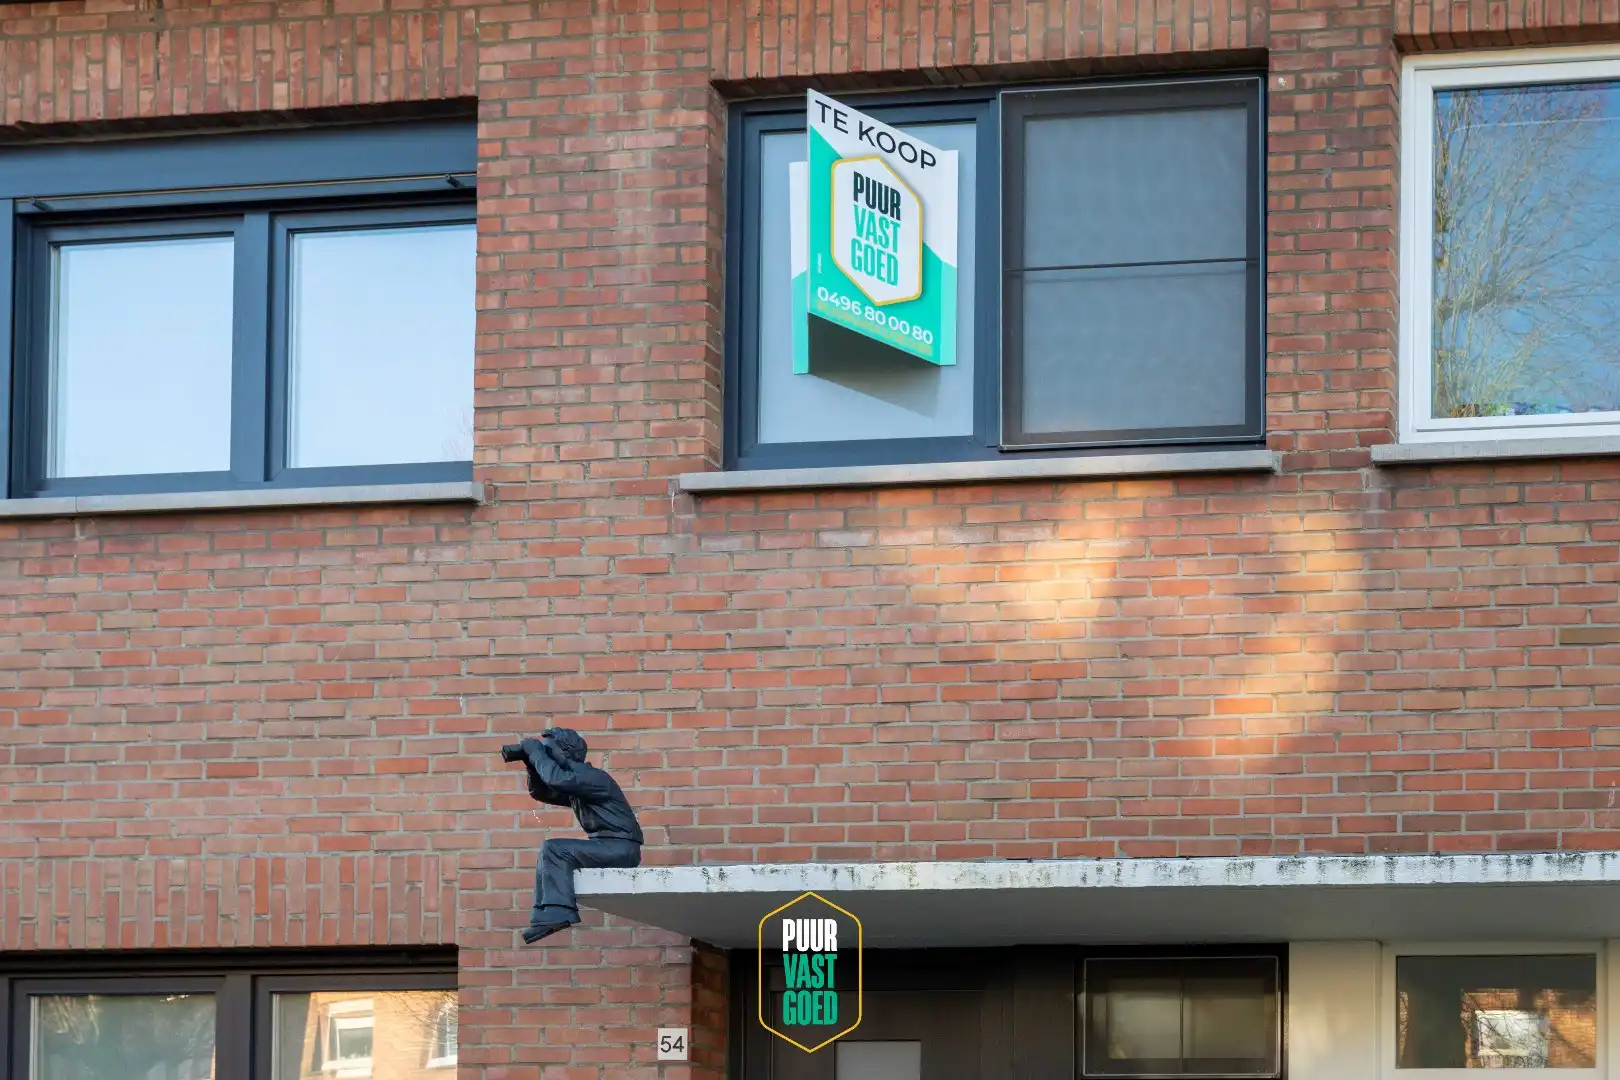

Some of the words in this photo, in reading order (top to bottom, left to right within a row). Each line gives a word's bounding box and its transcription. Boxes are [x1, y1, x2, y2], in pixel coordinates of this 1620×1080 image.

[815, 100, 848, 134] TE
[859, 120, 936, 169] KOOP
[853, 171, 901, 221] PUUR
[853, 204, 901, 253] VAST
[851, 238, 898, 286] GOED
[817, 287, 862, 315] 0496
[864, 306, 886, 326] 80
[888, 316, 910, 335] 00
[912, 325, 933, 345] 80
[660, 1035, 684, 1053] 54
